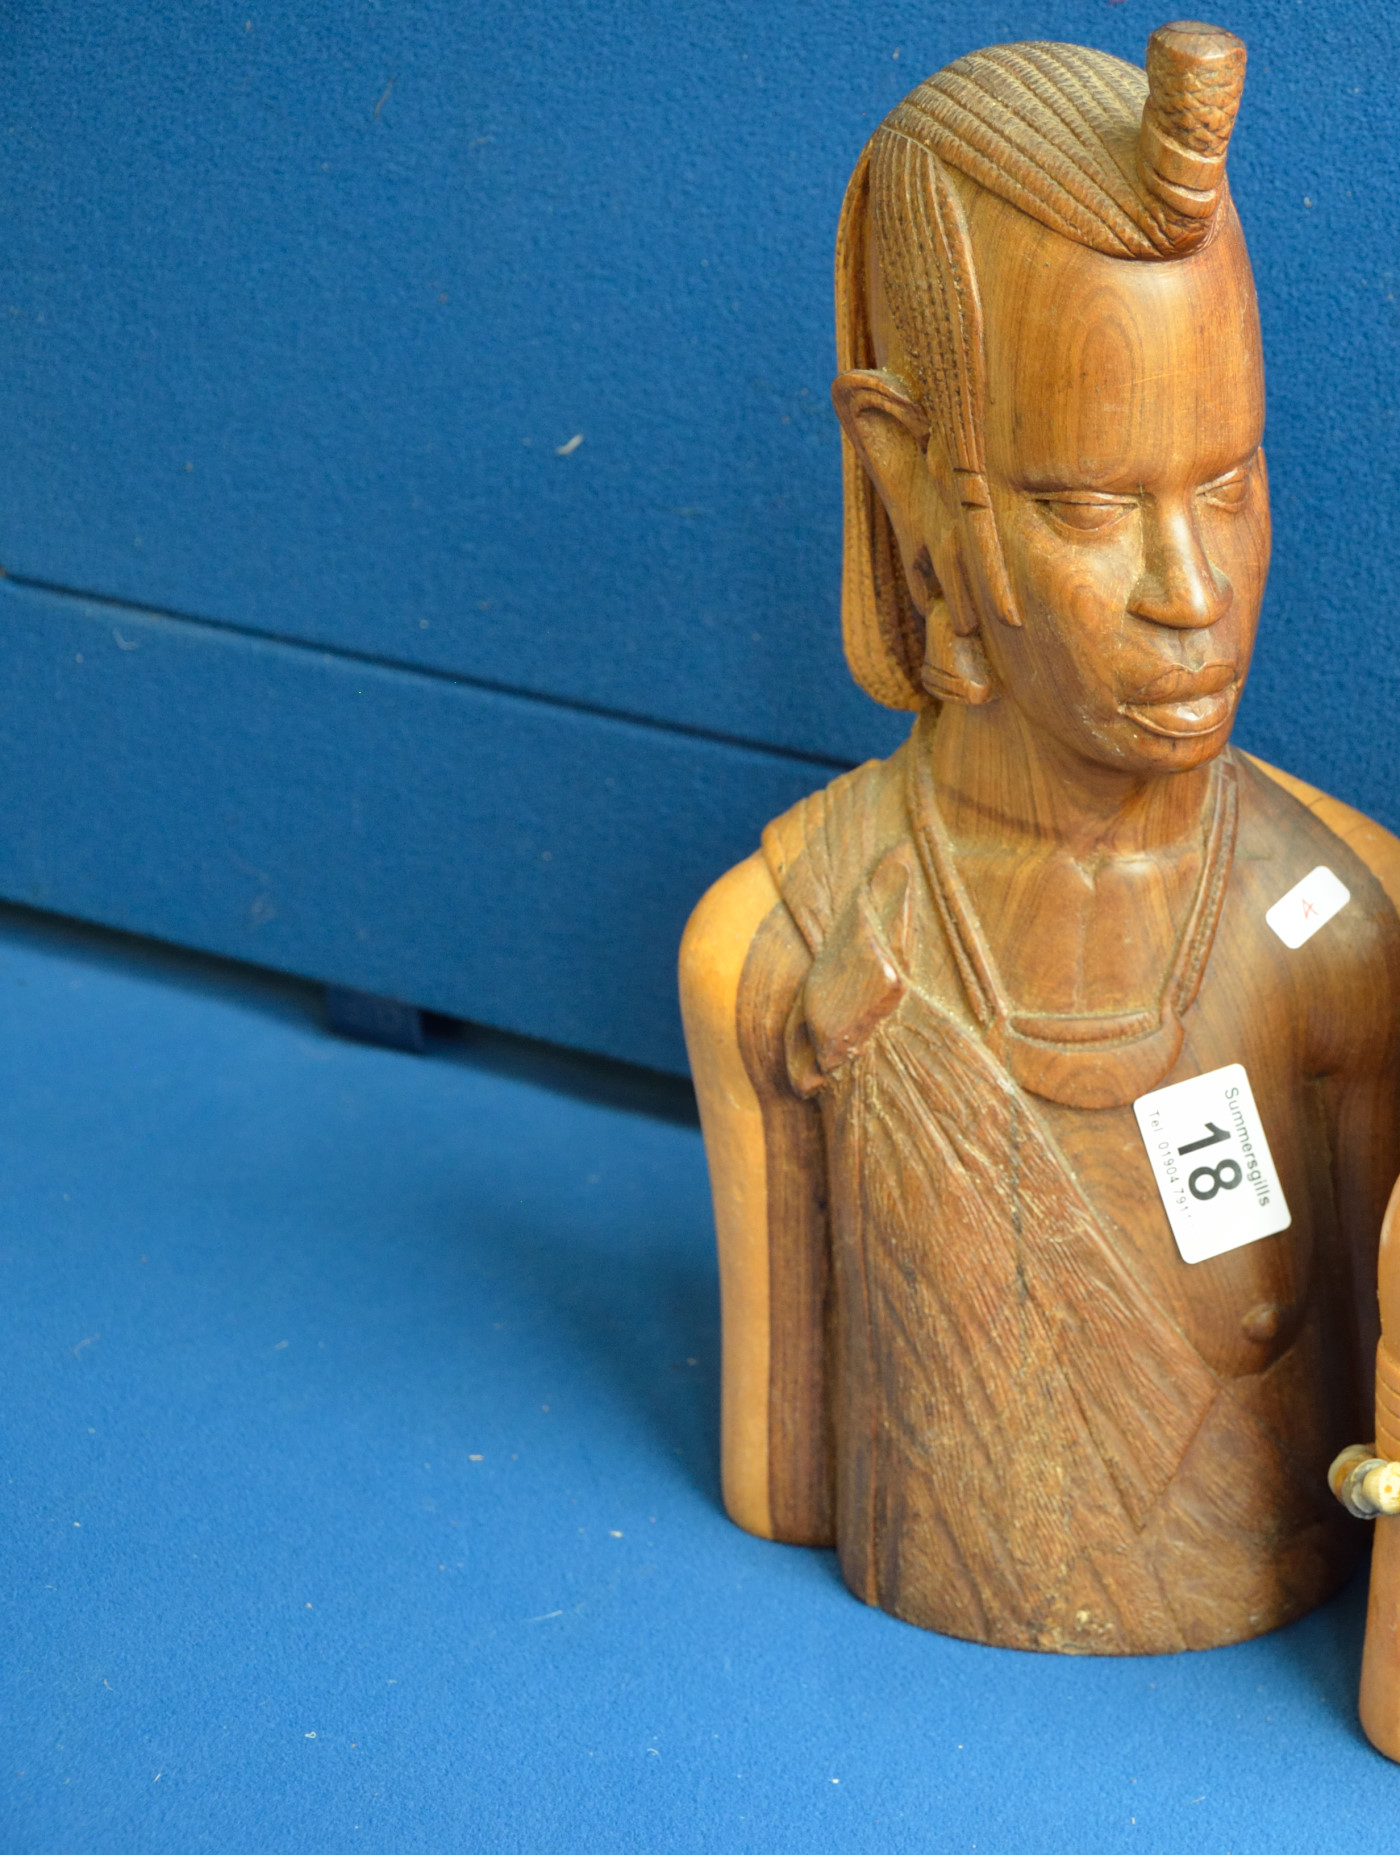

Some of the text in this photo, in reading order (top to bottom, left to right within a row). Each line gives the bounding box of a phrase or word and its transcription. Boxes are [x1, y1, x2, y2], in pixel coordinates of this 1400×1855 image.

[1158, 1141, 1180, 1184] 01904
[1177, 1122, 1243, 1201] 18
[1225, 1087, 1270, 1207] Summersgills
